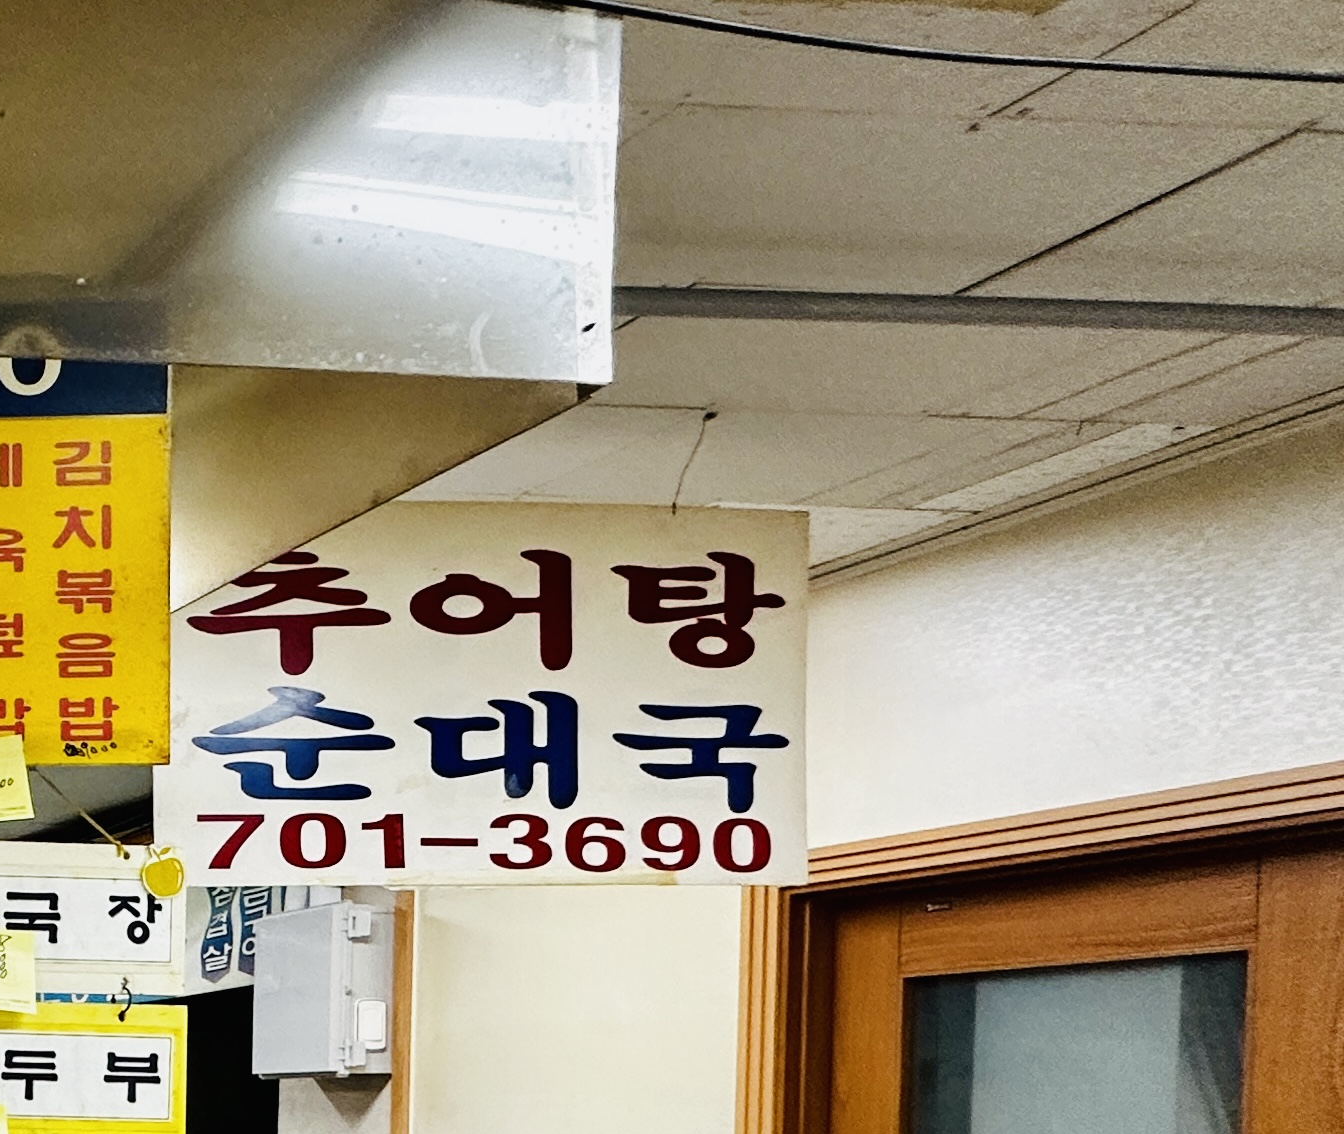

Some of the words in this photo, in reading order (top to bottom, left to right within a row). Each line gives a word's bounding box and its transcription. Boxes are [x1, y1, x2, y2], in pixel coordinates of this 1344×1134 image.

[54, 442, 118, 742] 김치볶음밥
[187, 549, 786, 676] 추어탕
[192, 686, 791, 813] 순대국
[196, 813, 773, 872] 701-3690
